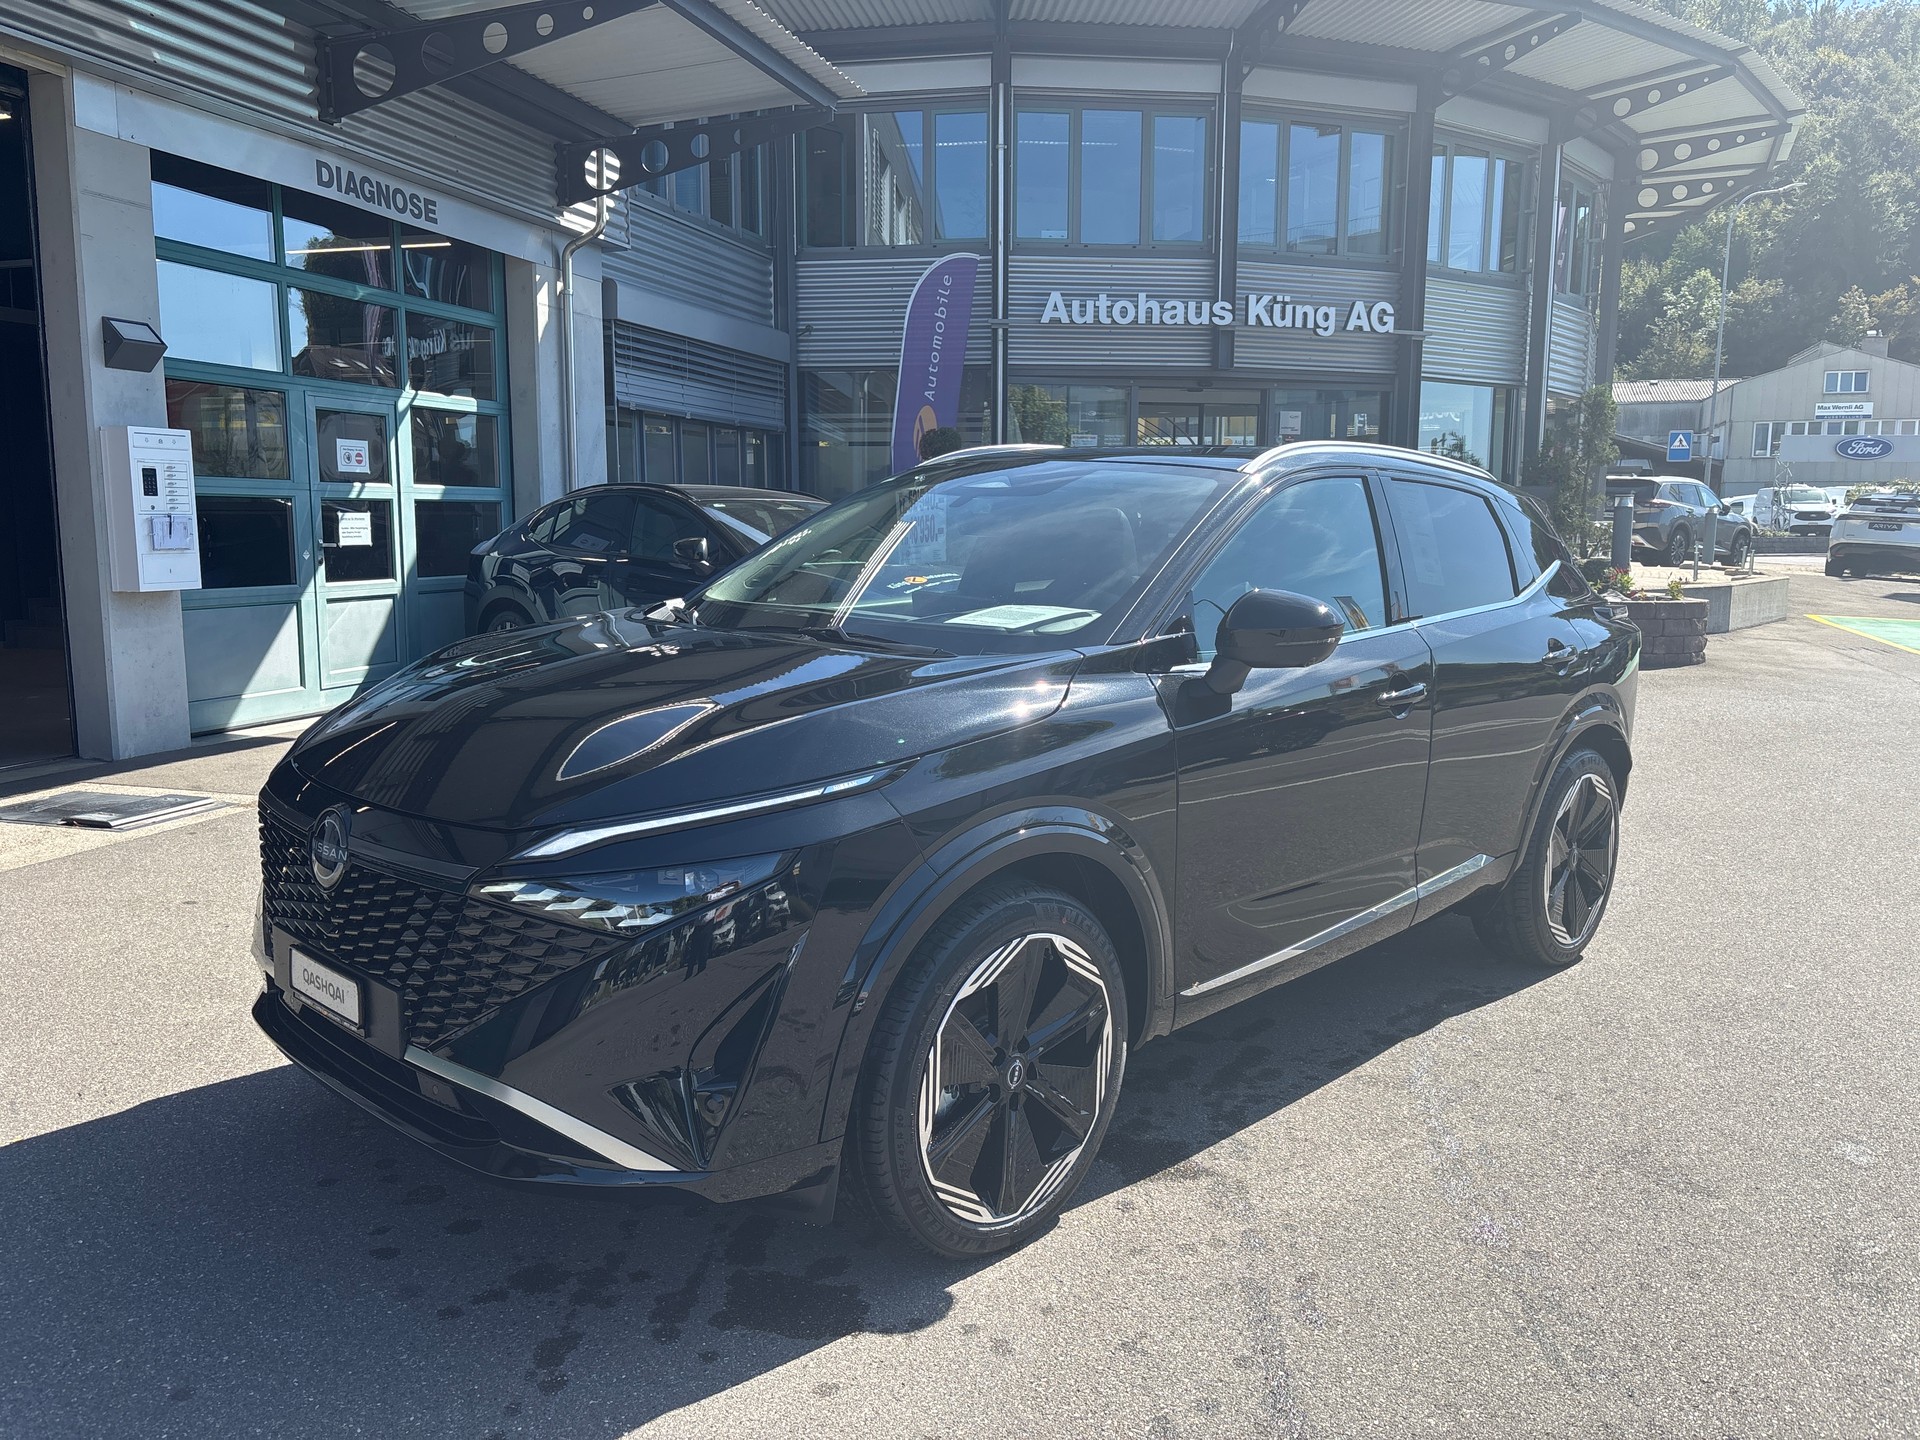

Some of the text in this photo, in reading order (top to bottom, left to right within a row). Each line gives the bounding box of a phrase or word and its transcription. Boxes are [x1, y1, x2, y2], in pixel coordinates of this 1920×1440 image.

[315, 158, 439, 225] DIAGNOSE
[1040, 291, 1396, 337] Autohaus Küng AG
[924, 274, 953, 402] Automobile
[1847, 440, 1883, 455] Ford
[314, 838, 348, 862] ISSAN
[302, 968, 345, 1004] QASHQAI
